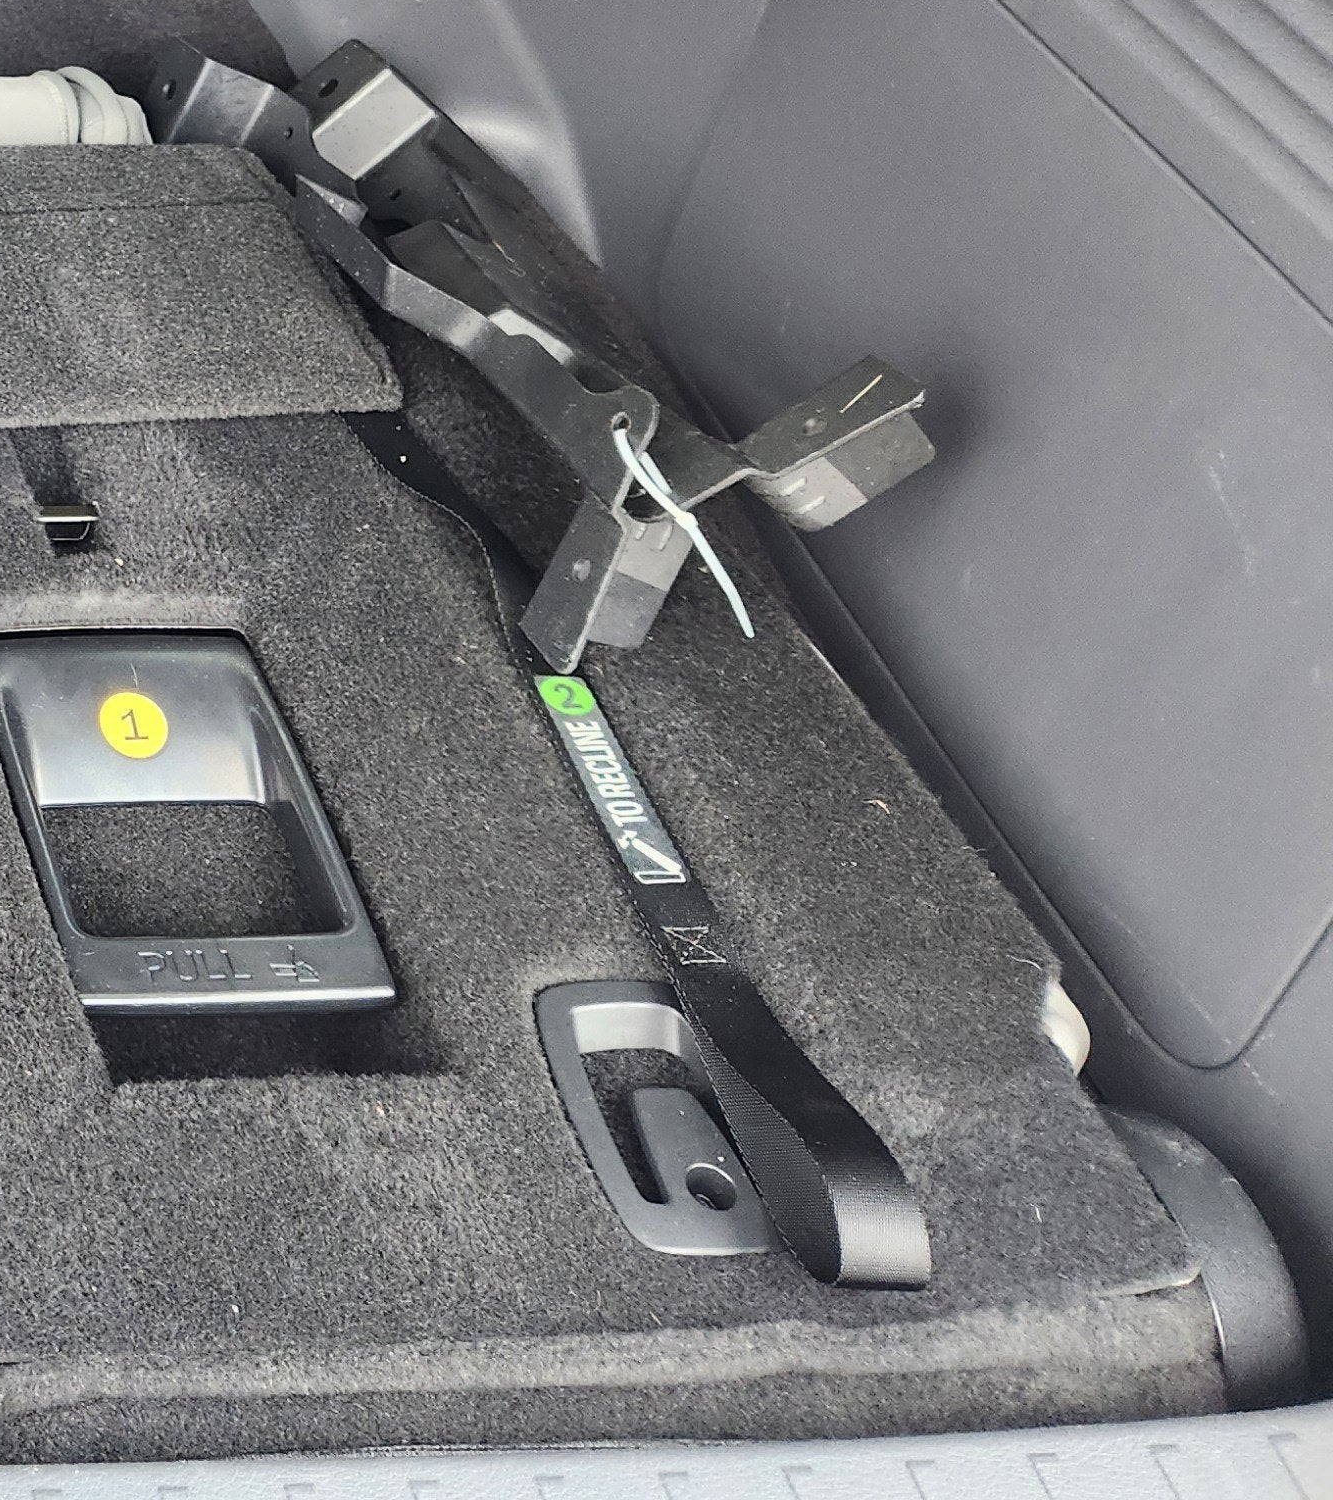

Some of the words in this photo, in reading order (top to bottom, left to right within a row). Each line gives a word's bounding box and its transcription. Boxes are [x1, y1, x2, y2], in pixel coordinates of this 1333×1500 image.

[552, 682, 583, 710] 2
[120, 708, 150, 741] 1
[564, 720, 635, 799] RECLINE
[606, 800, 649, 828] TO
[137, 948, 253, 984] PULL
